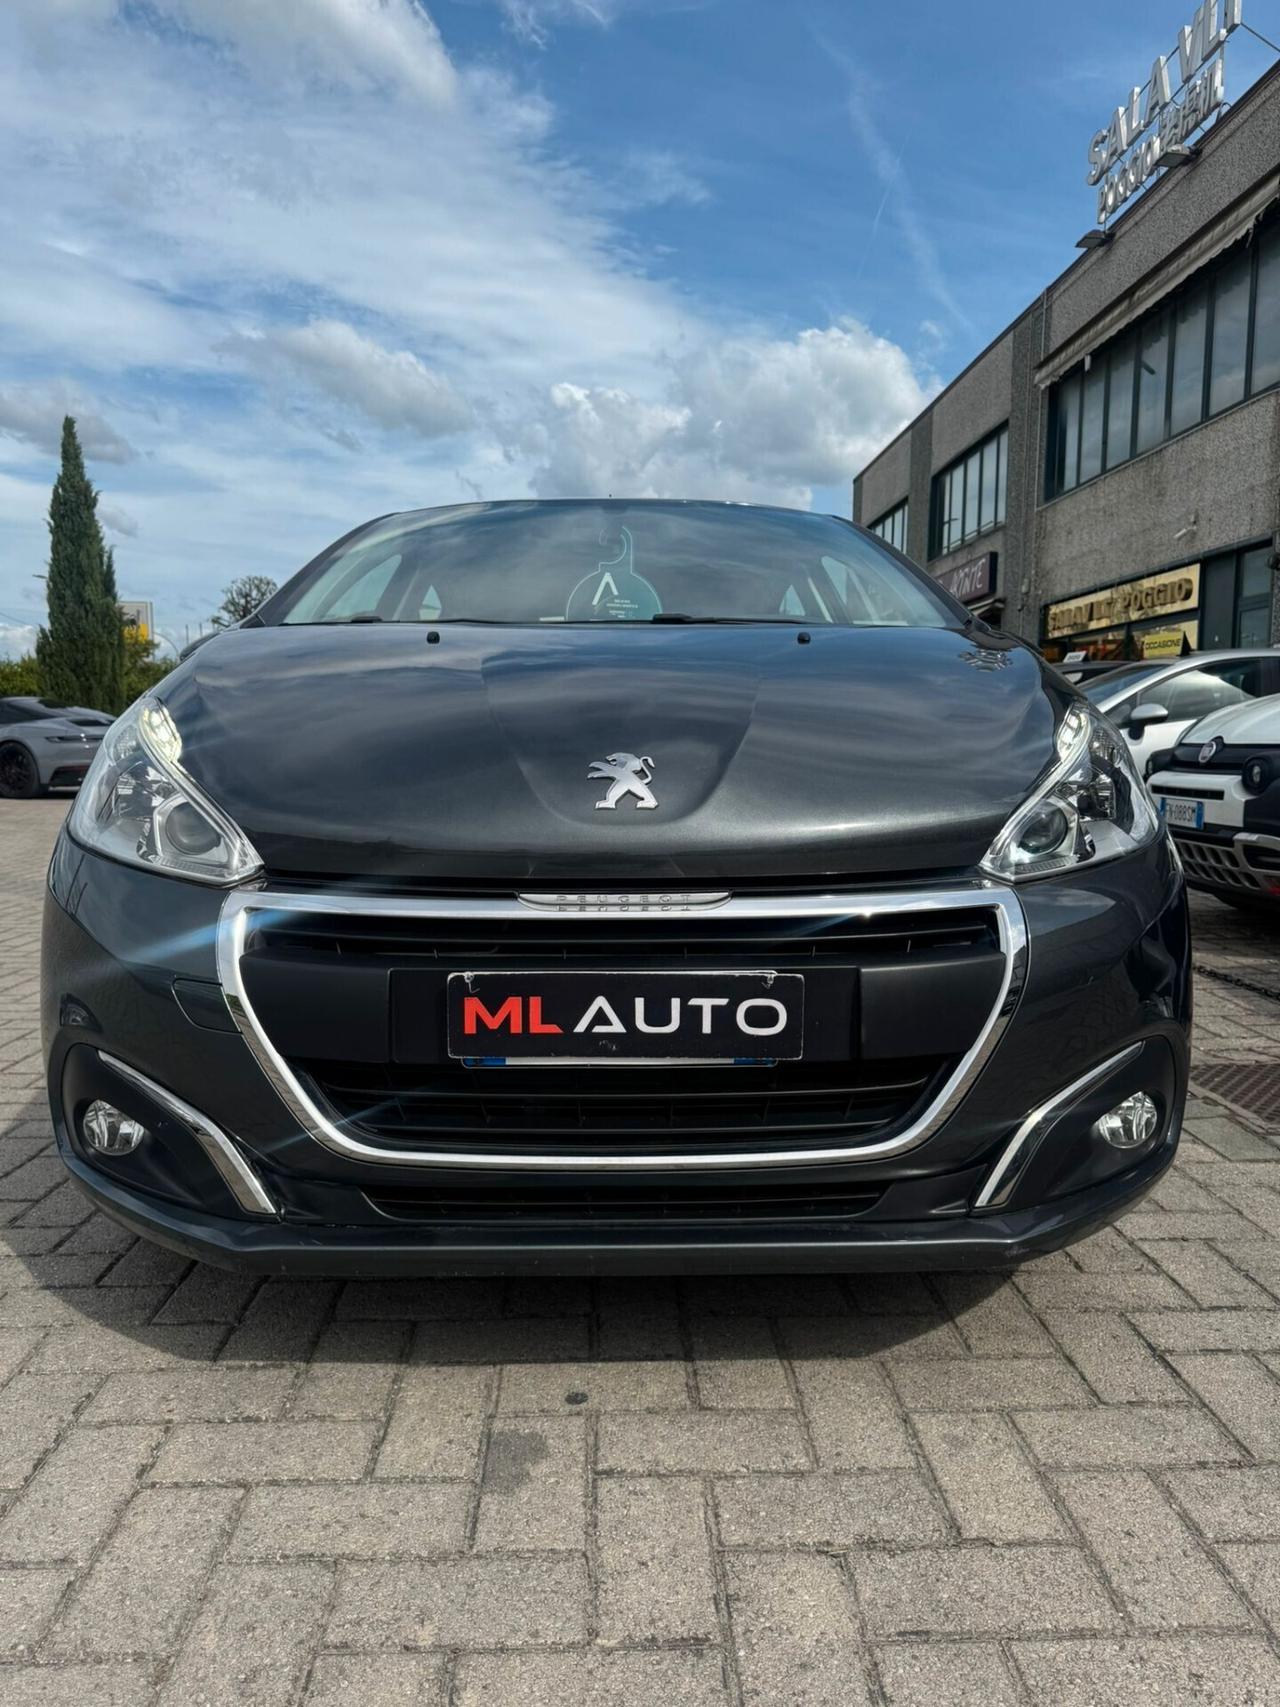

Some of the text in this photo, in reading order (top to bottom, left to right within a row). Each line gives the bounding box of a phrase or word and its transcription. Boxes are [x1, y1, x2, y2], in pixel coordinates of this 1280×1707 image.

[1088, 55, 1170, 186] SALA
[1097, 135, 1160, 224] POGGIO
[1123, 578, 1193, 612] POGGIO
[556, 894, 691, 905] PEUGEOT
[464, 995, 788, 1036] ML AUTO
